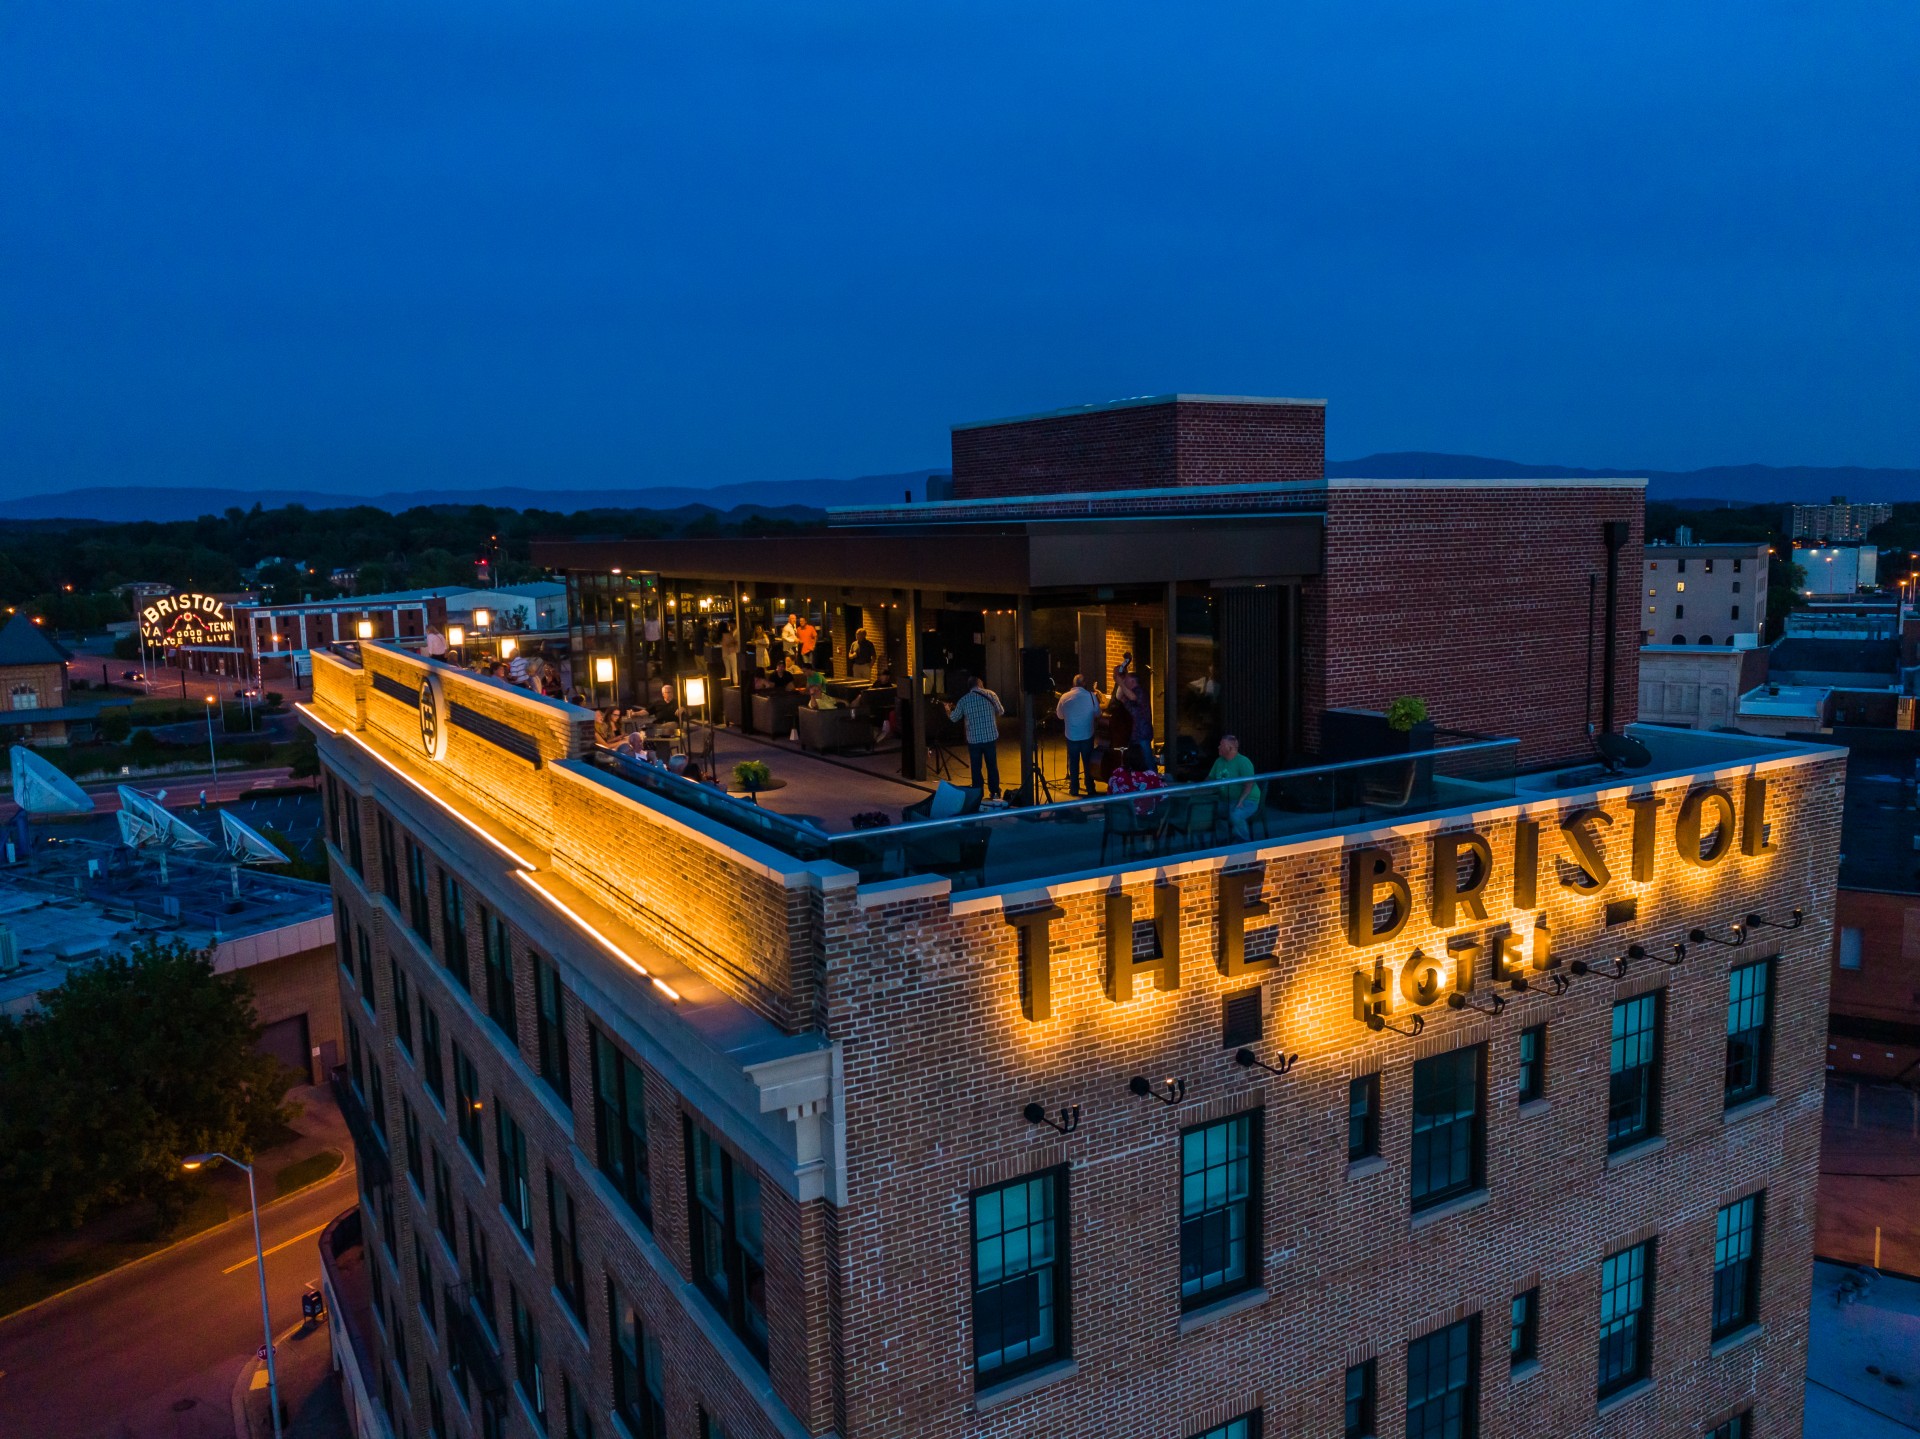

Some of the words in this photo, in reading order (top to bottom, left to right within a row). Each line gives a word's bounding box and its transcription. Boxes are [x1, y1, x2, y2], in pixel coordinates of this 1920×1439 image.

[143, 594, 224, 623] BRISTOL
[142, 626, 161, 637] VA
[208, 621, 234, 632] TENN
[148, 637, 183, 647] PLACE
[207, 634, 231, 642] LIVE
[1004, 869, 1279, 1022] THE
[1348, 779, 1777, 948] BRISTOL
[1353, 922, 1562, 1022] HOTEL
[259, 1347, 275, 1357] ST
